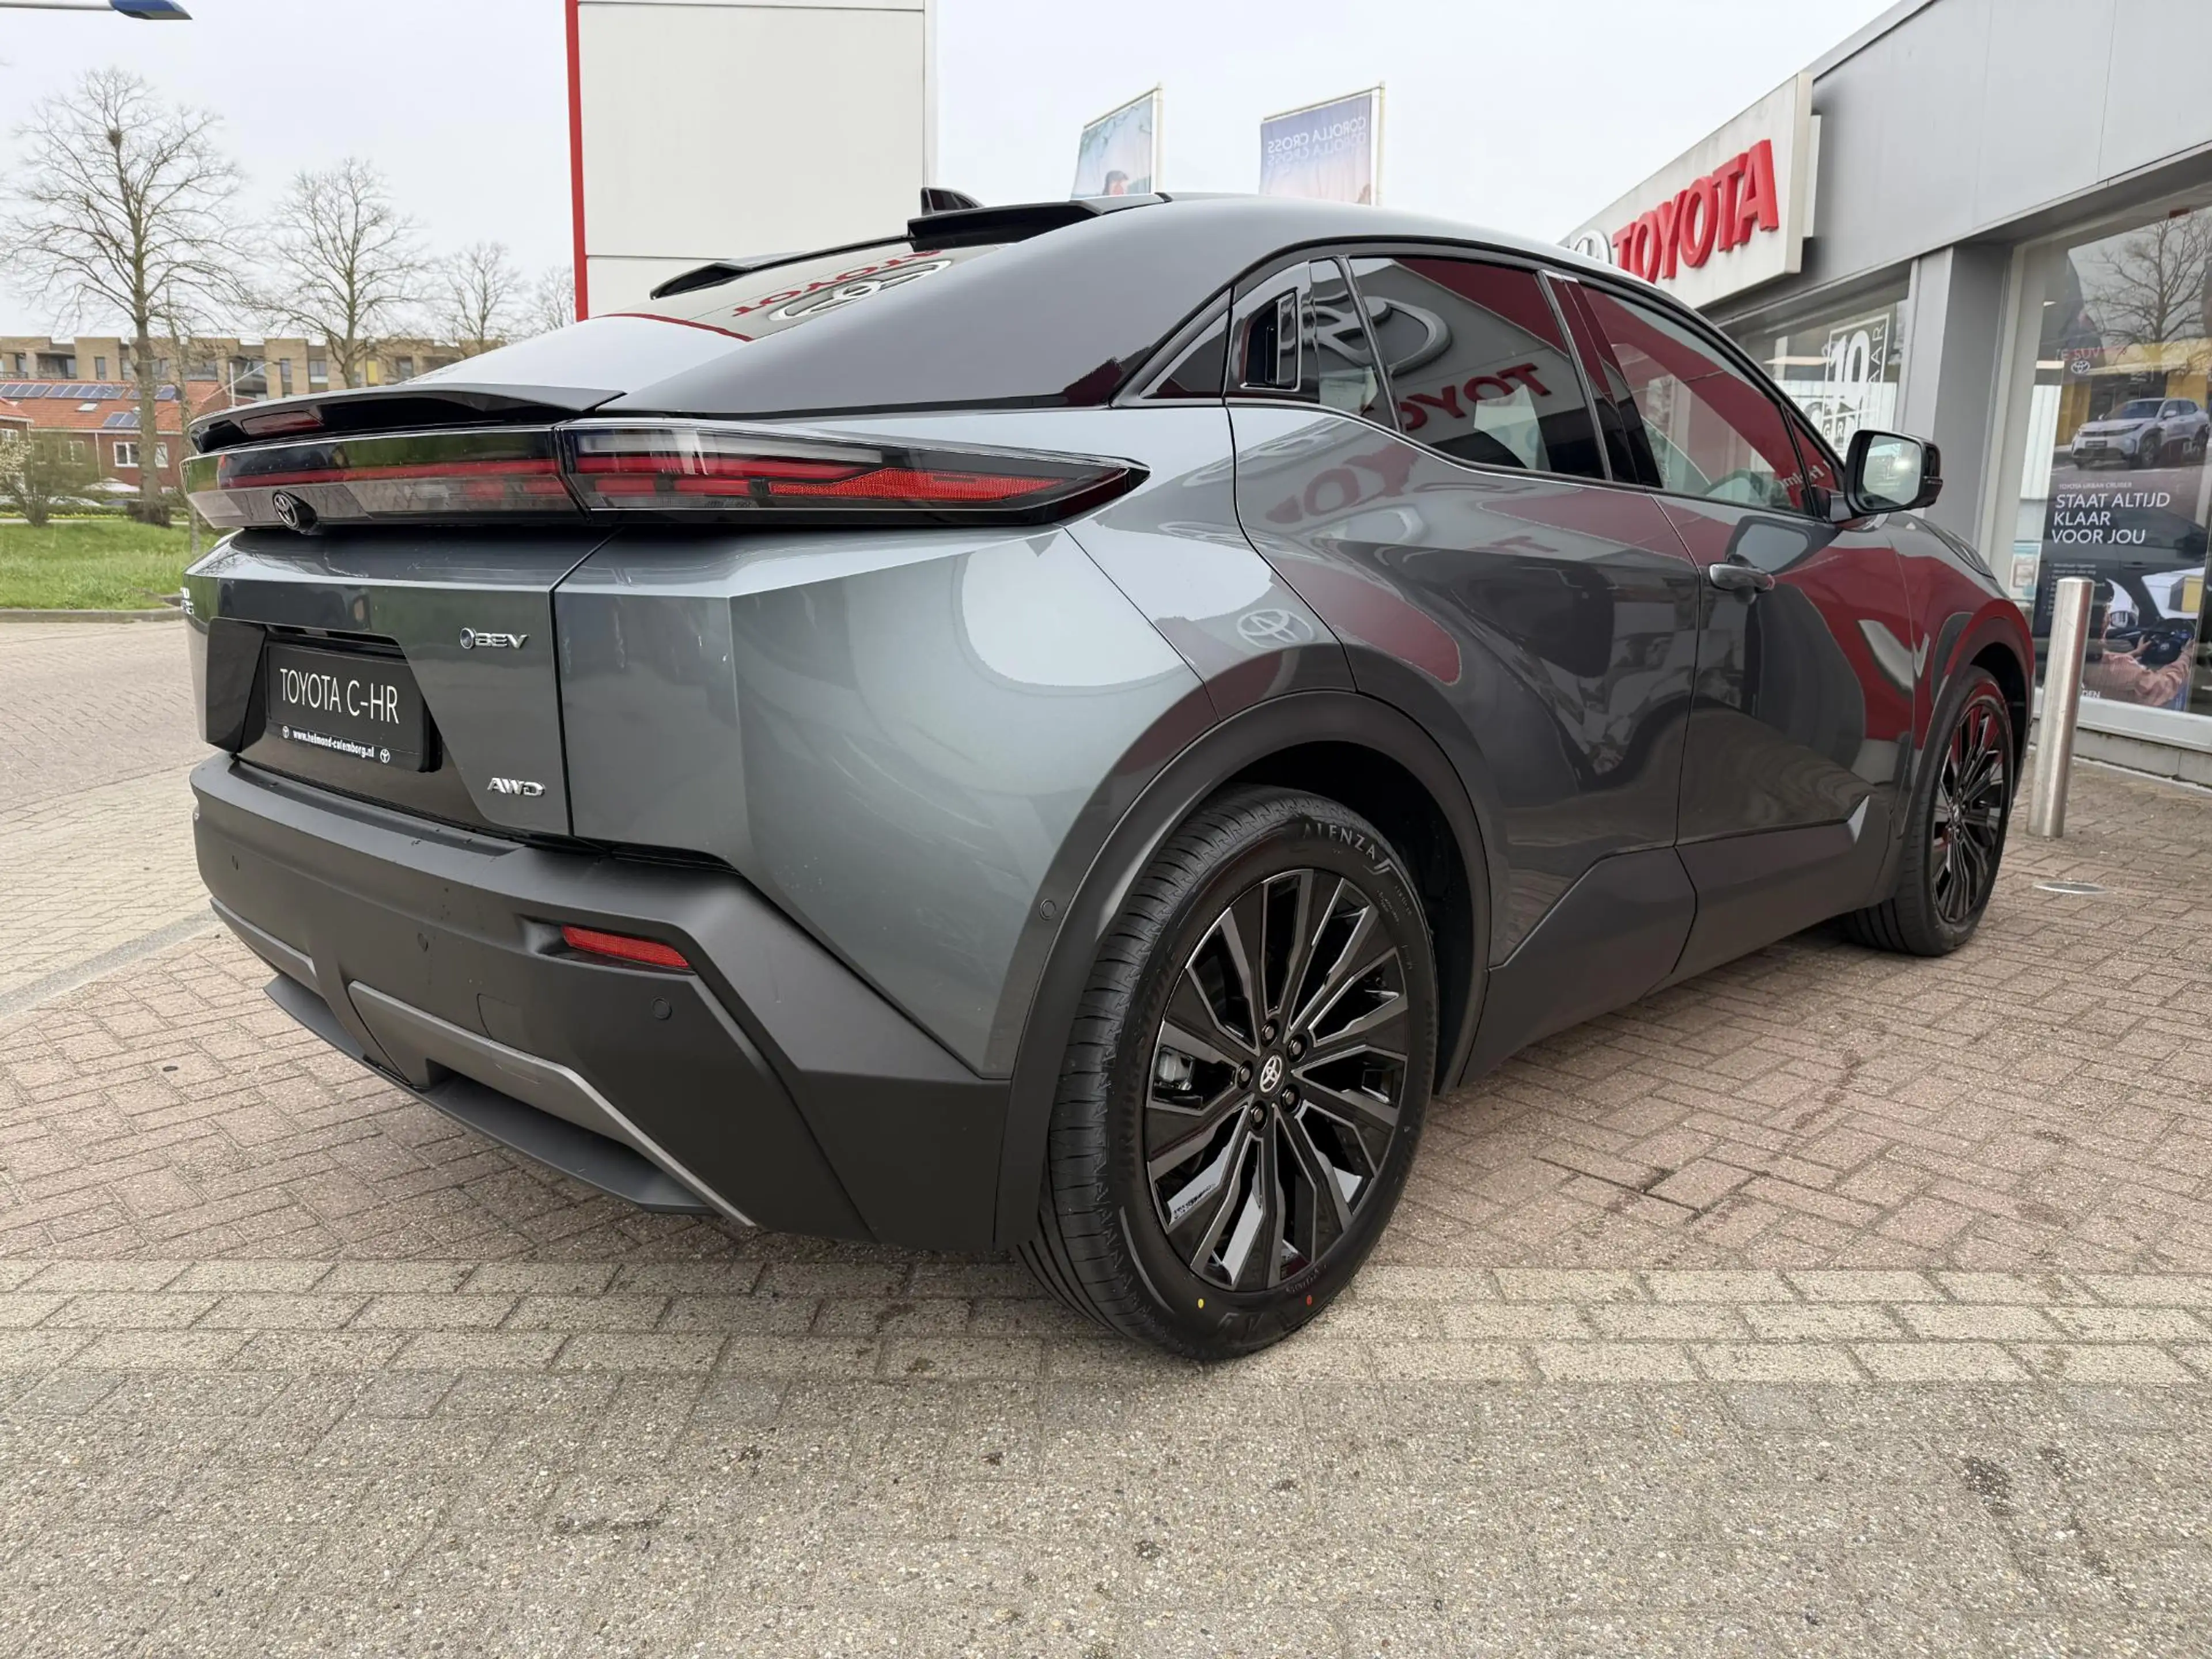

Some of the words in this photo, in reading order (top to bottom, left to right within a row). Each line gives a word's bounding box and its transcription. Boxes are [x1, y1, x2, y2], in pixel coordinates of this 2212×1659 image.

[1612, 139, 1779, 284] TOYOTA
[2055, 493, 2108, 509] STAAT
[2111, 492, 2171, 507] ALTIJD
[2054, 511, 2111, 526] KLAAR
[2051, 529, 2104, 544] VOOR
[2107, 529, 2146, 544] JOU
[475, 632, 531, 649] BEV
[280, 668, 341, 713] TOYOTA
[347, 679, 399, 724] C-HR
[487, 778, 546, 797] AWD
